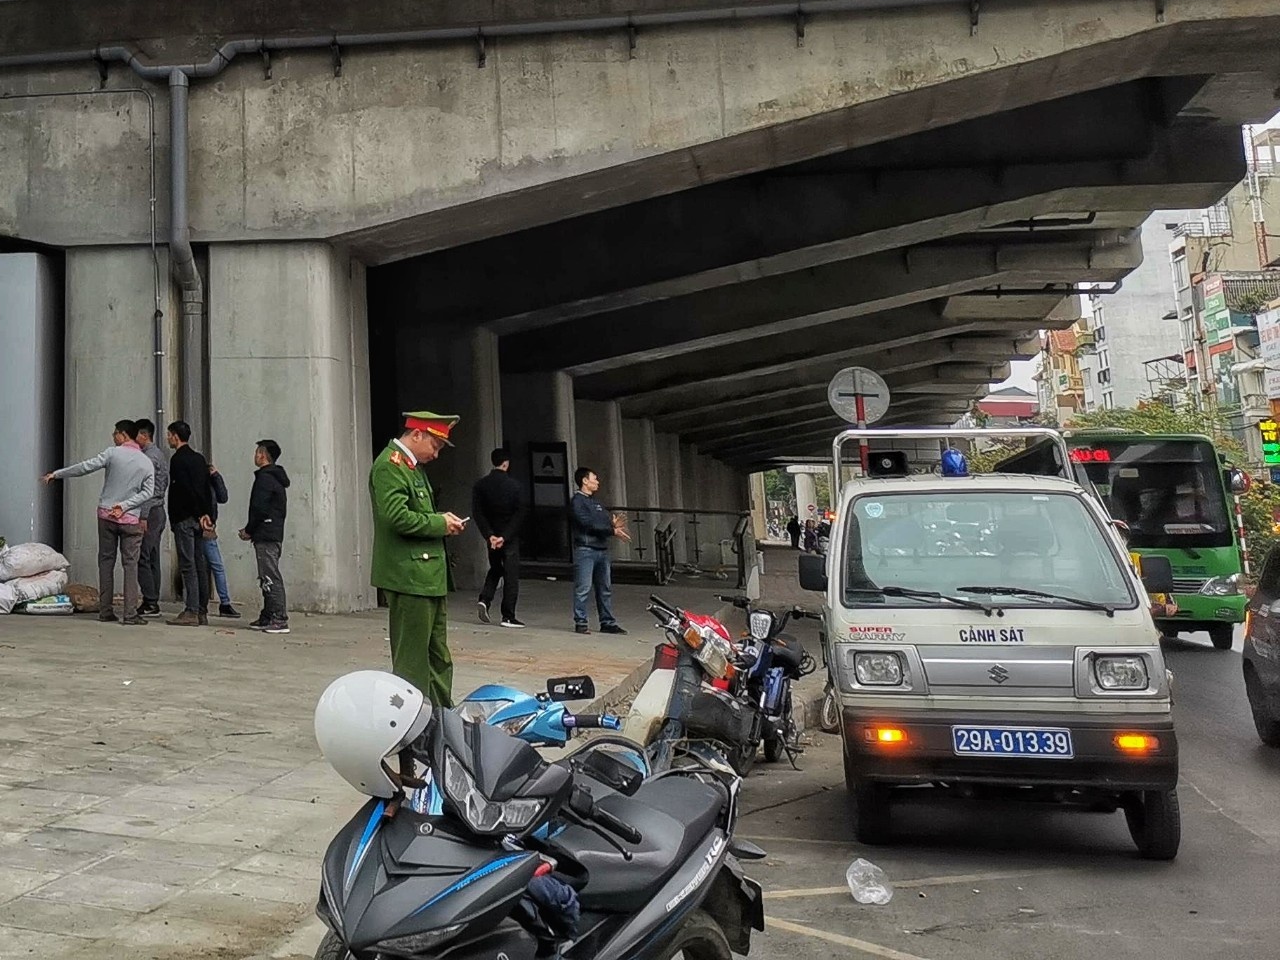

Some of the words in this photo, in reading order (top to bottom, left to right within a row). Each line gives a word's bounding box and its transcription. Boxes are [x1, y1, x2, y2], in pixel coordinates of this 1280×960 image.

[849, 632, 906, 641] CARRY
[959, 625, 996, 643] CẢNH
[1000, 627, 1024, 642] SÁT
[957, 730, 1068, 753] 29A-013.39
